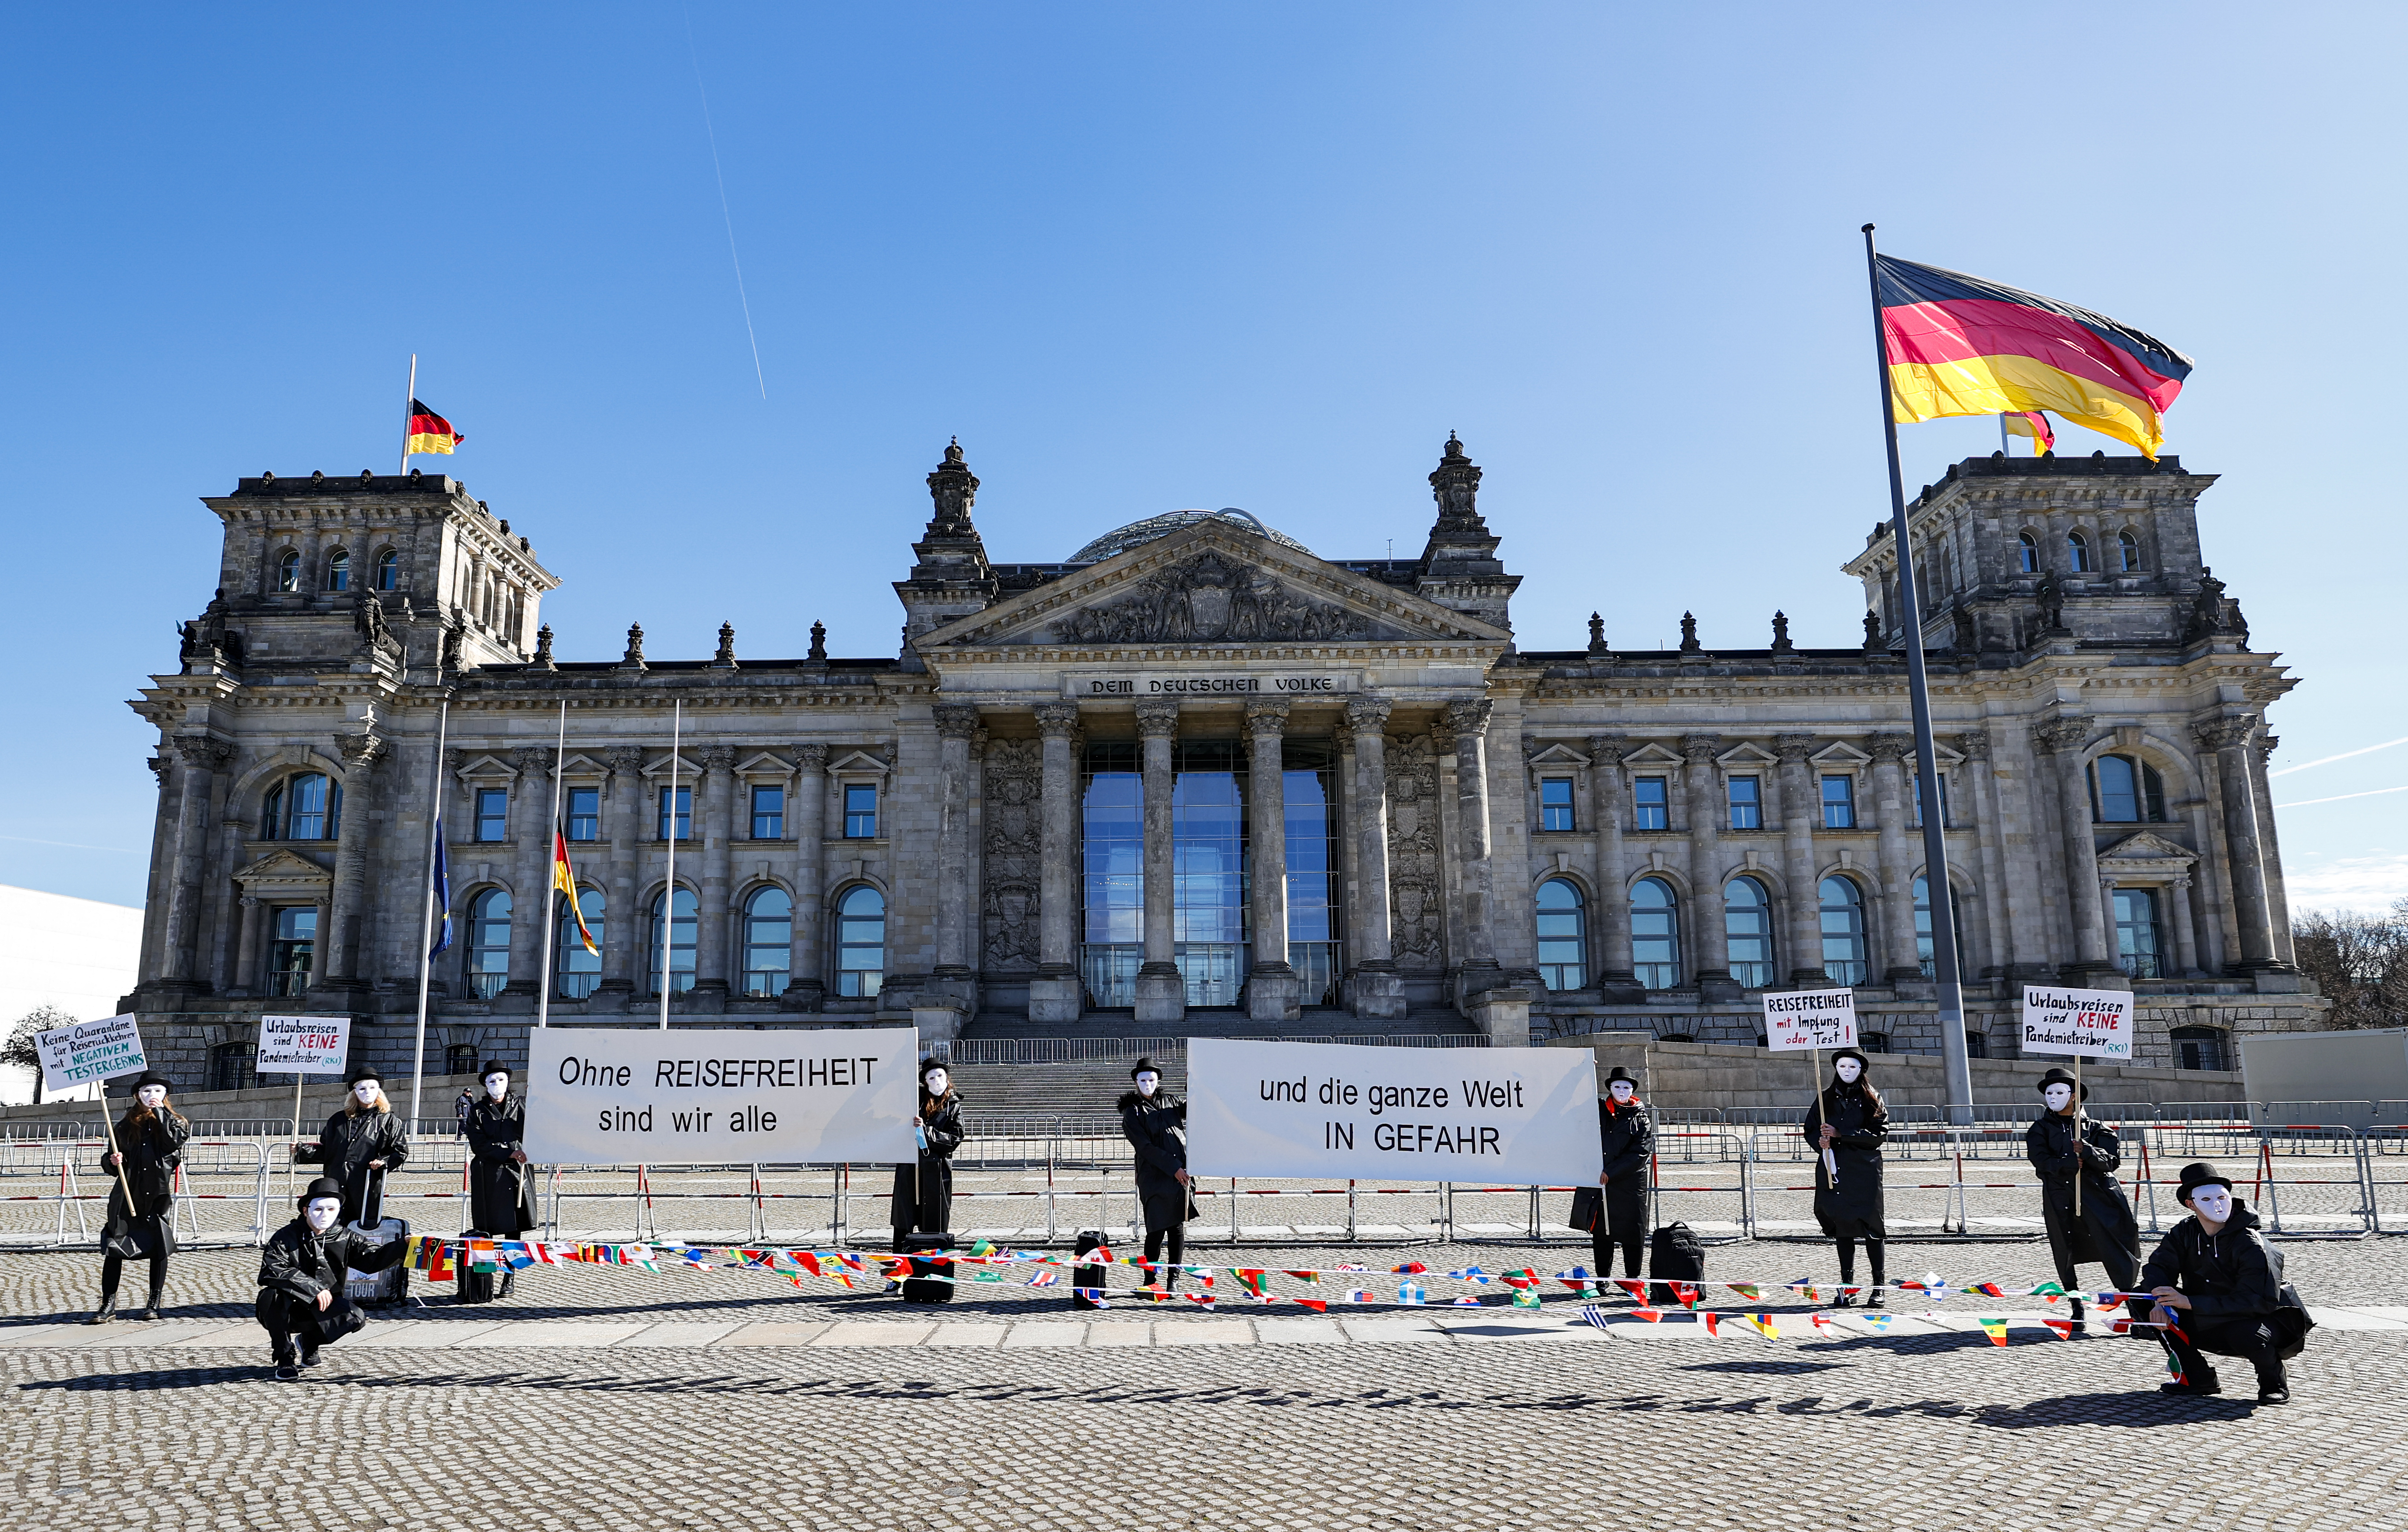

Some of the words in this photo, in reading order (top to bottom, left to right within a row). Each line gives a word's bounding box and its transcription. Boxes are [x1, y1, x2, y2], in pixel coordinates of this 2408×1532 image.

[1091, 680, 1133, 693] DEM
[1149, 679, 1258, 692] DEUTSCHEN
[1275, 678, 1332, 691] VOLKE
[1769, 994, 1851, 1012] REISEFREIHEIT
[2029, 992, 2123, 1012] Urlaubsreisen
[267, 1020, 337, 1033] Urlaubsreisen
[1777, 1017, 1792, 1029] mit
[1798, 1014, 1839, 1031] Impfung
[2043, 1012, 2069, 1023] sind
[2077, 1012, 2120, 1030] KEINE
[41, 1034, 70, 1048] Keine
[75, 1021, 130, 1039] Quarantäne
[53, 1046, 67, 1057] für
[69, 1032, 136, 1053] Reiserückkehrer
[273, 1035, 293, 1045] sind
[298, 1034, 340, 1049] KEINE
[1786, 1032, 1808, 1044] oder
[2026, 1025, 2108, 1046] Pandemietreiber
[2104, 1042, 2128, 1055] (RKI)
[50, 1059, 65, 1070] mit
[72, 1042, 129, 1066] NEGATIVEM
[259, 1049, 322, 1063] Pandemietreiber
[322, 1056, 342, 1067] (RKI)
[63, 1053, 144, 1080] TESTERGEBNIS
[560, 1056, 631, 1086] Ohne
[655, 1058, 878, 1087] REISEFREIHEIT
[1261, 1076, 1306, 1103] und
[1319, 1077, 1358, 1105] die
[1368, 1086, 1448, 1115] ganze
[1462, 1080, 1523, 1108] Welt
[599, 1104, 652, 1132] sind
[672, 1107, 713, 1132] wir
[730, 1105, 777, 1132] alle
[1326, 1121, 1353, 1149] IN
[1375, 1123, 1501, 1155] GEFAHR
[350, 1283, 374, 1297] TOUR
